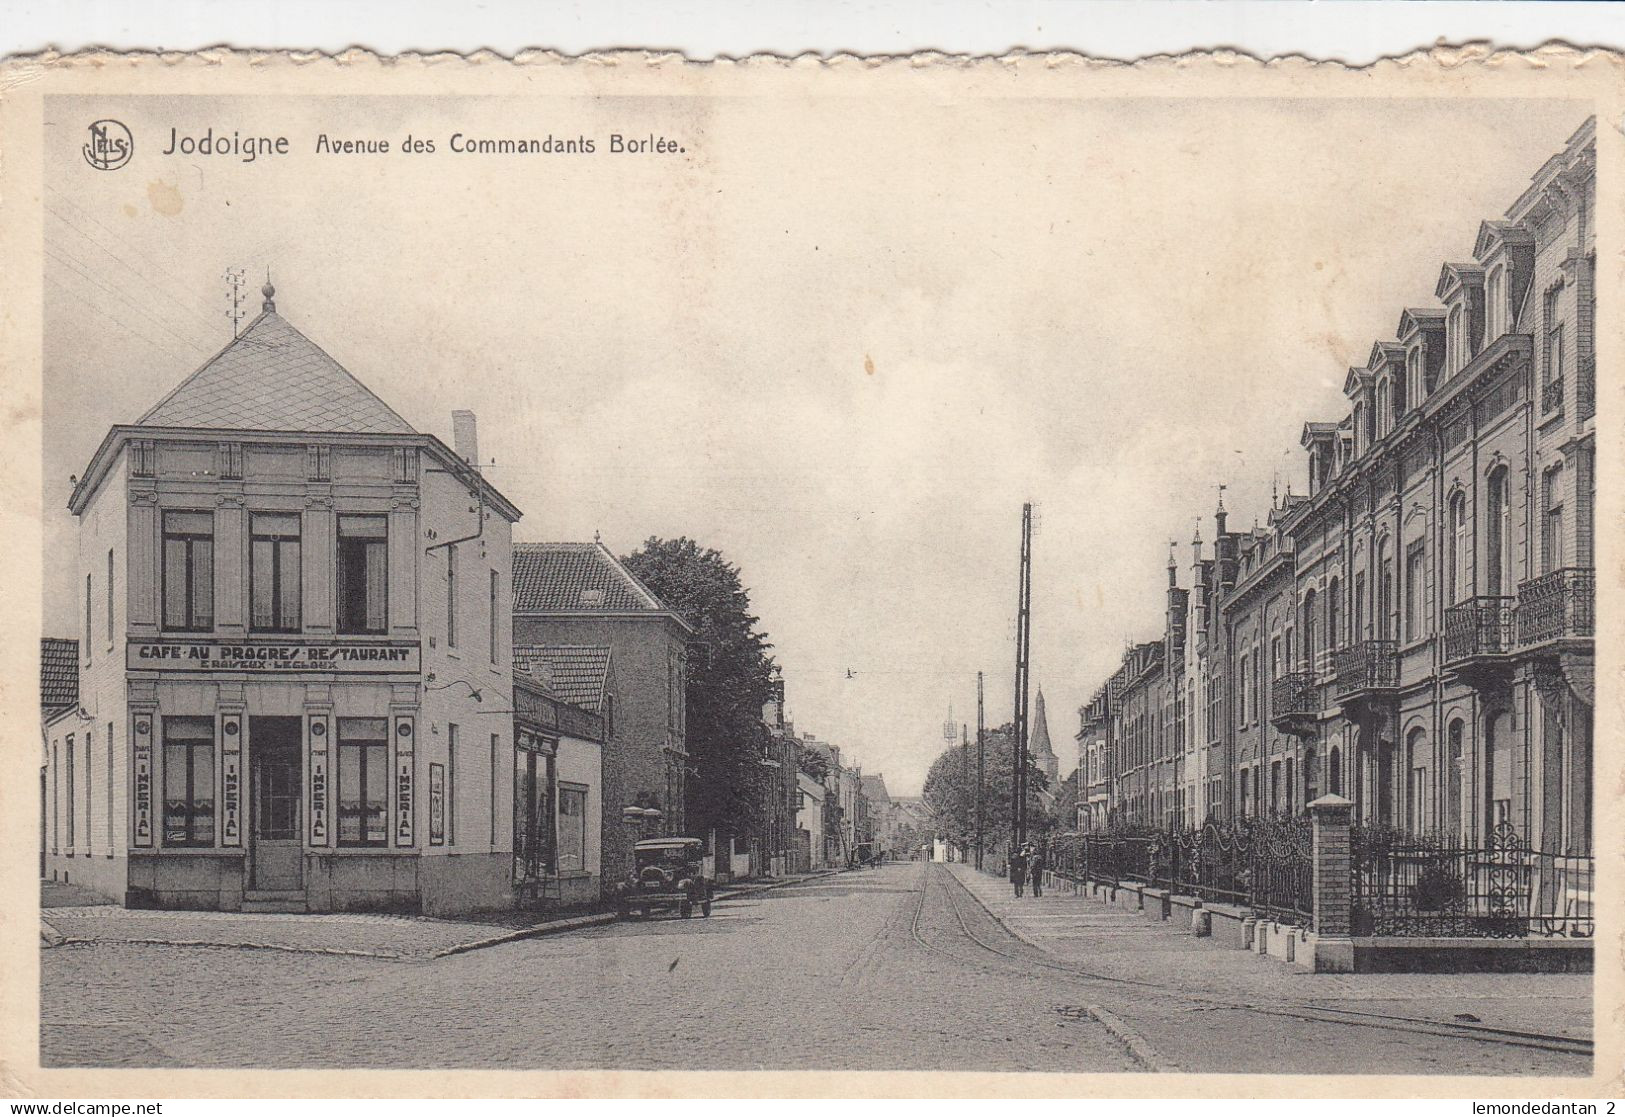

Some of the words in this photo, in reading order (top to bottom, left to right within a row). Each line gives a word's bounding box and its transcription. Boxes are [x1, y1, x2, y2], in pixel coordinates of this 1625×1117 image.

[307, 647, 410, 661] RESTAURANT
[137, 764, 149, 837] IMPERIAL
[225, 764, 237, 837] IMPERIAL
[313, 764, 324, 838] IMPERIAL
[399, 765, 411, 838] IMPERIAL
